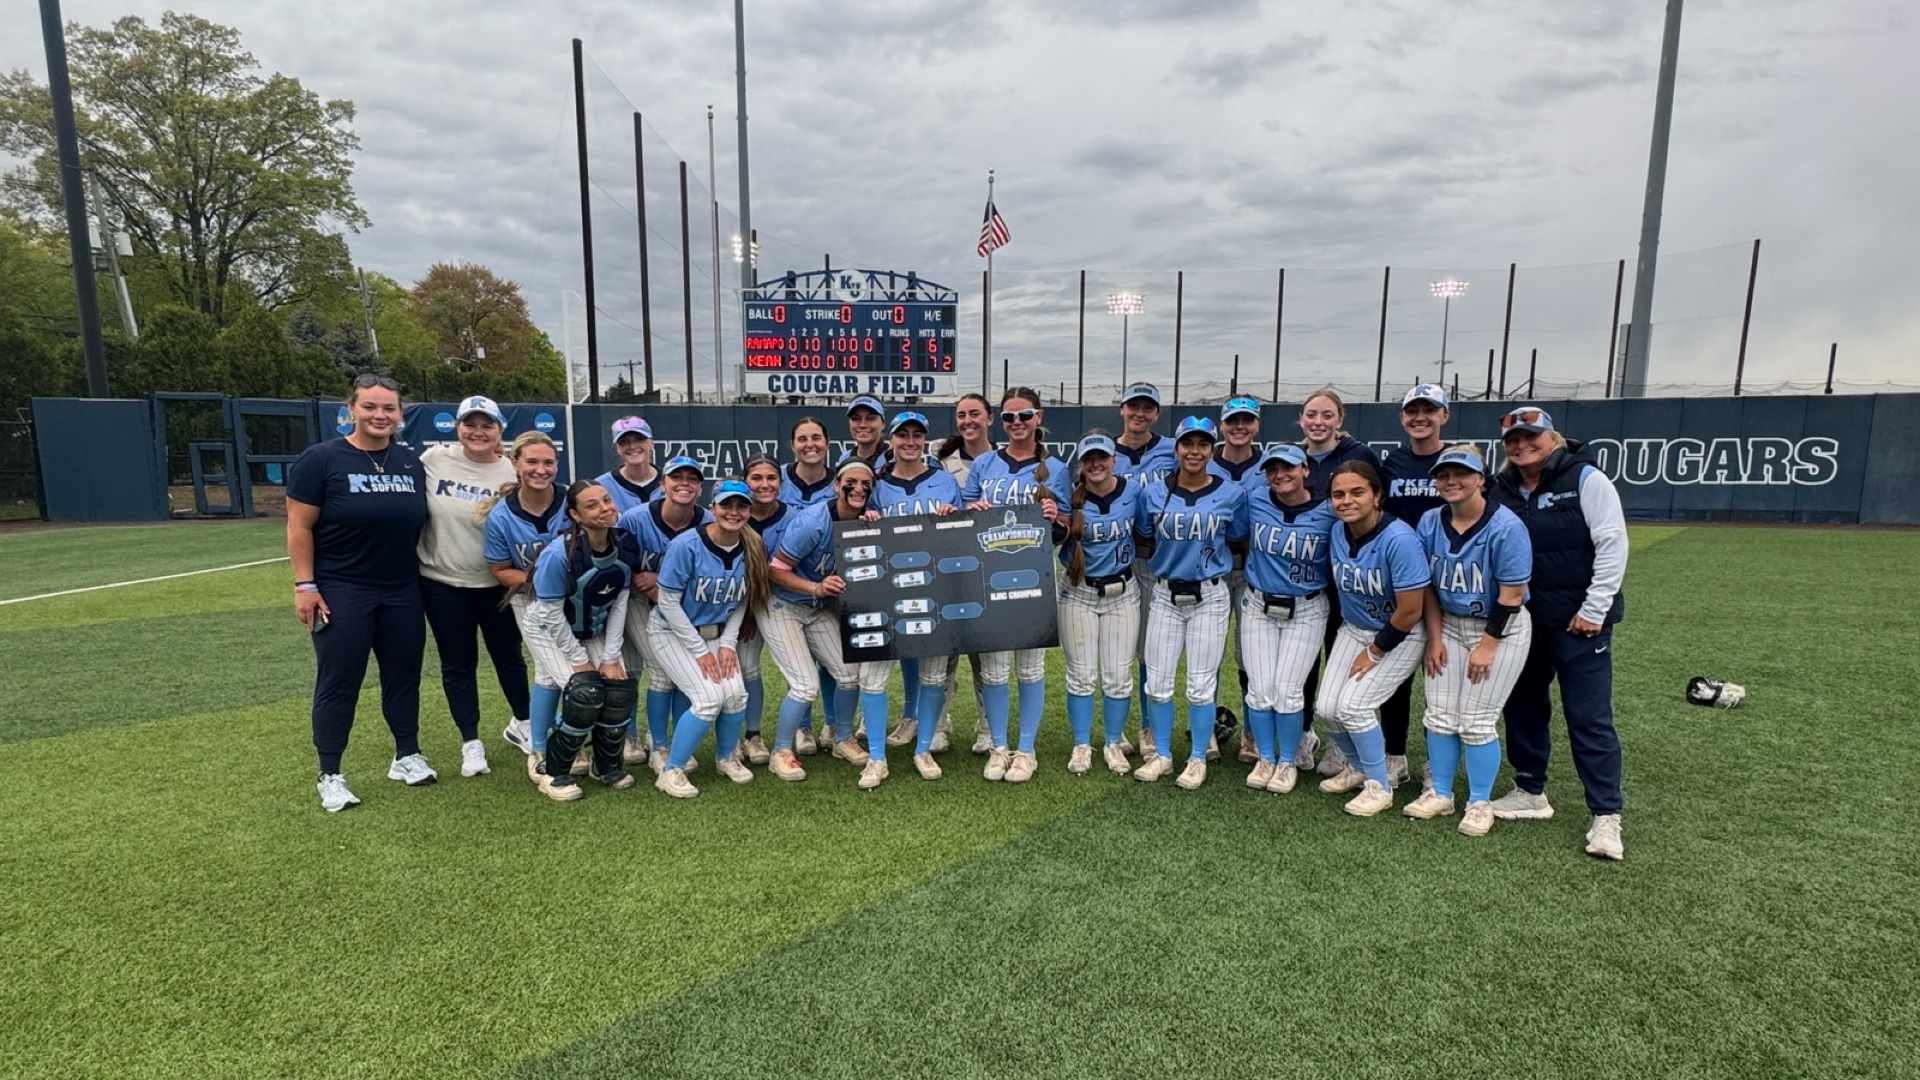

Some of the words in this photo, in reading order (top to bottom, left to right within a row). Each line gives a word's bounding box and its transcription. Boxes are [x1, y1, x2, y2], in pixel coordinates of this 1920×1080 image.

[748, 309, 774, 320] BALL
[774, 305, 785, 323] 0
[804, 309, 840, 320] STRIKE
[841, 305, 851, 323] 0
[871, 309, 893, 321] OUT
[893, 306, 904, 323] 0
[924, 309, 942, 322] H/E
[790, 328, 796, 337] 1
[801, 328, 808, 337] 2
[813, 328, 820, 337] 3
[828, 328, 834, 337] 4
[840, 328, 846, 337] 5
[851, 328, 858, 337] 6
[866, 328, 872, 337] 7
[877, 328, 884, 337] 8
[889, 328, 911, 338] RUNS
[918, 328, 937, 338] HITS
[940, 328, 956, 338] ERR
[788, 337, 798, 351] 0
[811, 337, 821, 351] 0
[838, 337, 847, 351] 0
[849, 337, 859, 351] 0
[864, 337, 873, 352] 0
[902, 337, 911, 352] 2
[928, 338, 937, 352] 6
[789, 354, 797, 368] 2
[800, 354, 809, 369] 0
[811, 354, 821, 369] 0
[826, 354, 835, 369] 0
[849, 354, 859, 369] 0
[902, 355, 911, 370] 3
[929, 355, 937, 368] 7
[942, 355, 952, 370] 2
[768, 375, 859, 394] COUGAR
[868, 375, 935, 394] FIELD
[1589, 438, 1839, 486] OUGARS
[369, 475, 414, 484] KEAN
[371, 483, 416, 493] SOFTBALL
[1405, 479, 1438, 487] KEA
[1084, 517, 1135, 543] EAN
[1154, 512, 1220, 541] KEAN
[982, 529, 1041, 545] CHAMPIONSHIP
[1252, 521, 1322, 562] KEAN
[1114, 543, 1131, 567] 16
[694, 575, 749, 605] KEAN
[1469, 600, 1485, 618] 2
